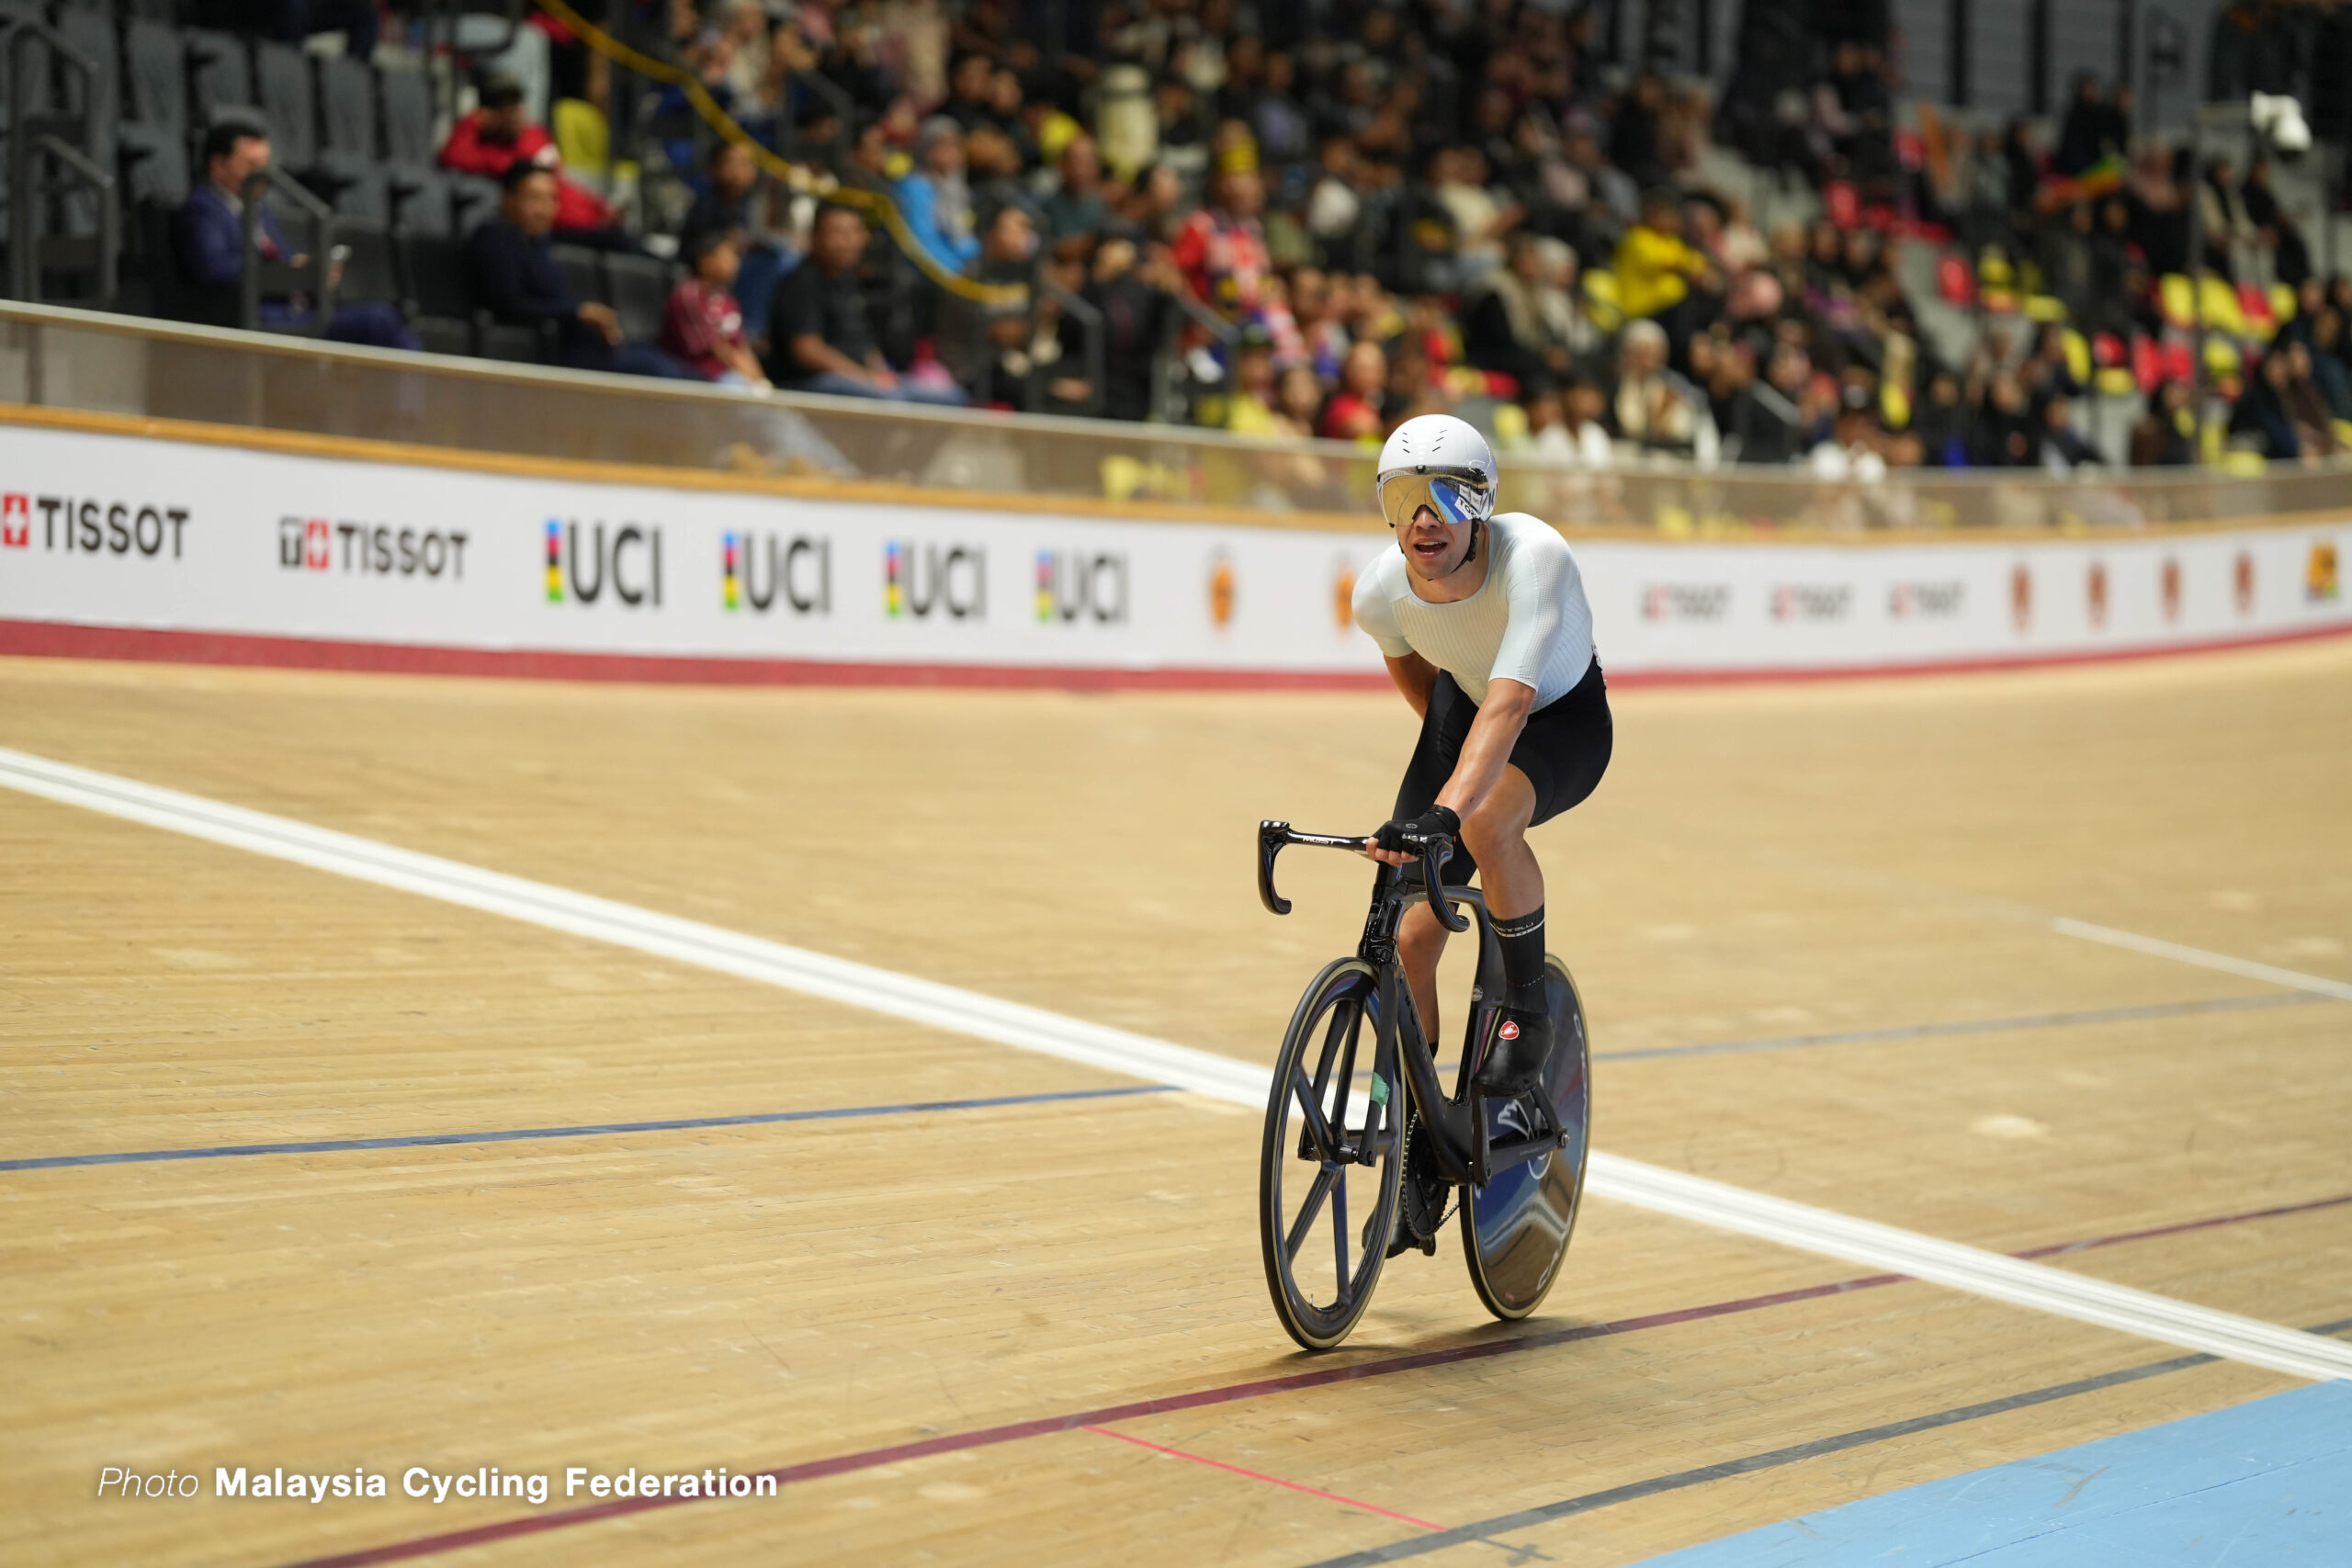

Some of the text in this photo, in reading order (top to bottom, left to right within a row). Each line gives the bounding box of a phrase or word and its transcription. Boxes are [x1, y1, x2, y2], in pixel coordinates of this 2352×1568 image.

[37, 497, 190, 558] TISSOT
[336, 522, 468, 578] TISSOT
[567, 522, 662, 608] UCI
[742, 533, 831, 615] UCI
[904, 544, 986, 620] UCI
[1054, 553, 1127, 624] UCI
